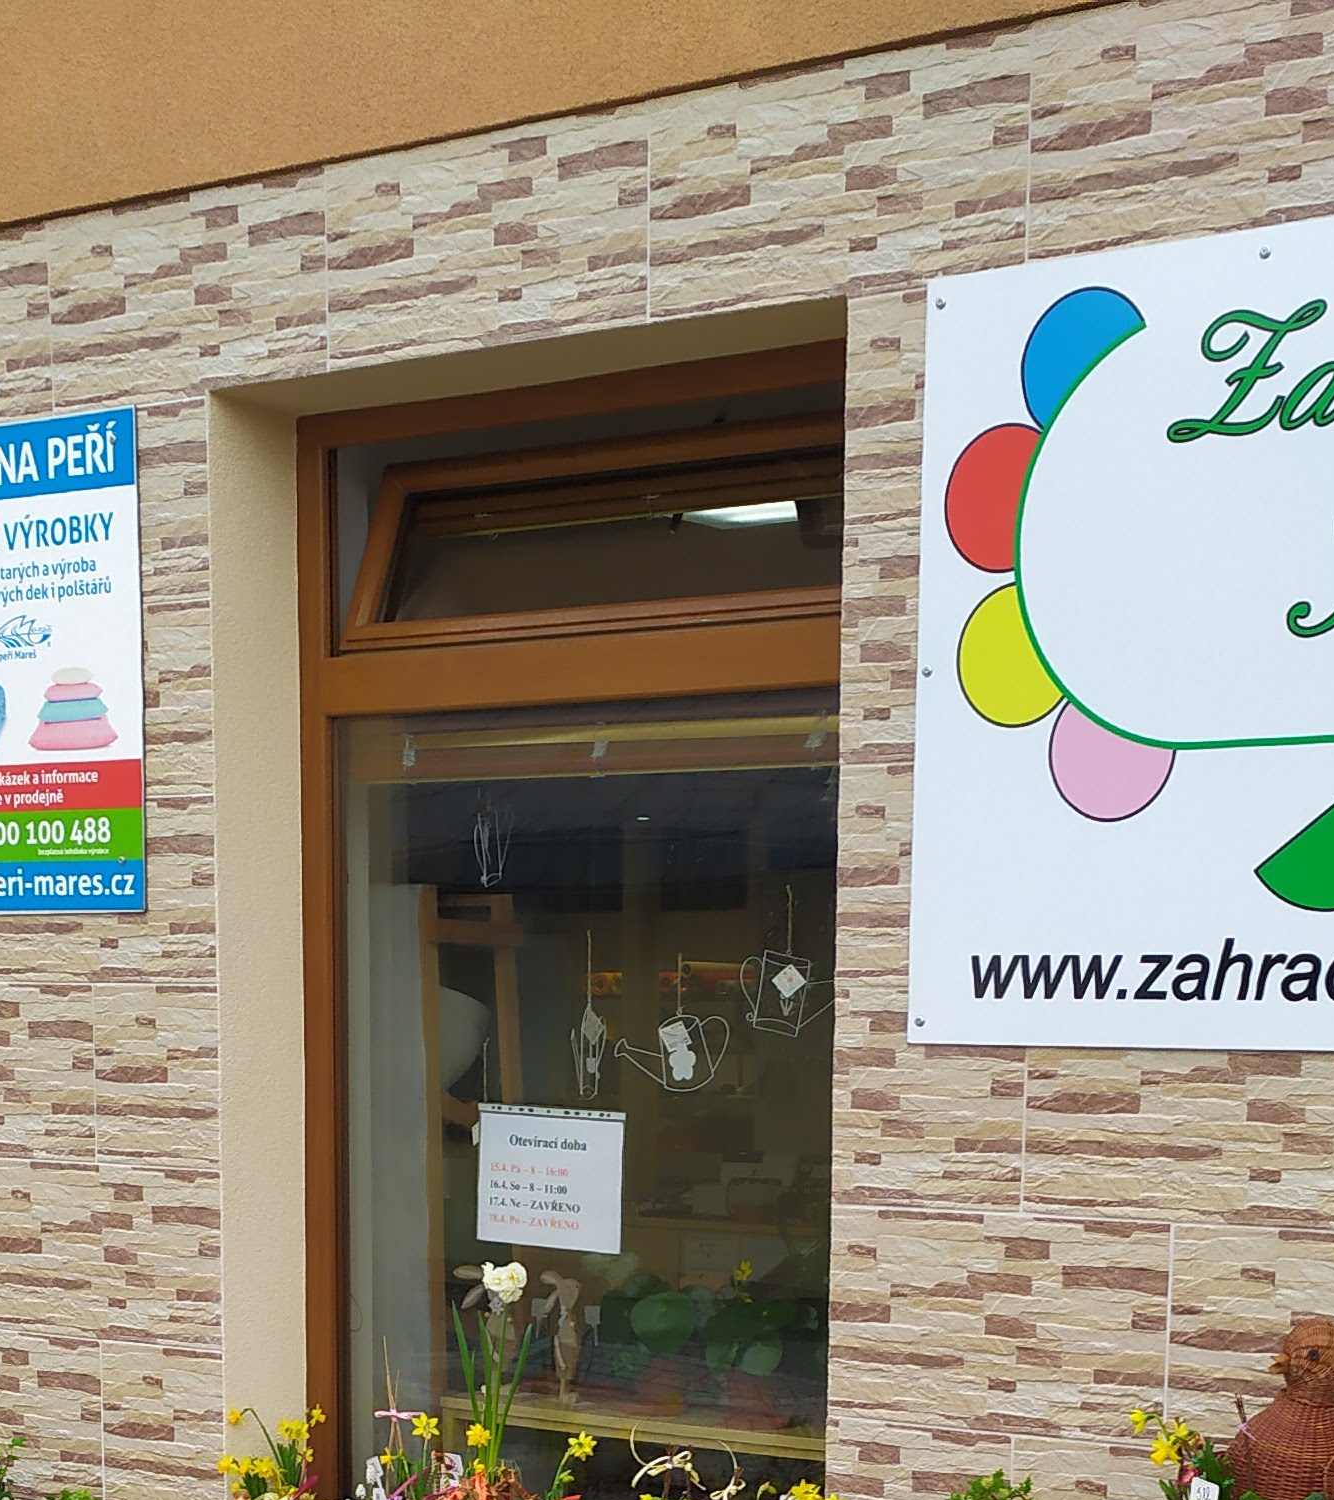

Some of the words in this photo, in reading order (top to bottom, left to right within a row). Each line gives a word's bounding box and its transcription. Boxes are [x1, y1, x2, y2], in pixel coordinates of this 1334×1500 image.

[47, 421, 117, 480] PEŘÍ
[4, 511, 114, 551] VÝROBKY
[42, 563, 50, 576] a
[51, 556, 97, 579] výroba
[25, 582, 49, 602] dek
[51, 582, 56, 598] i
[57, 575, 113, 602] polštářů
[32, 773, 40, 785] a
[41, 768, 99, 784] informace
[4, 793, 11, 805] v
[13, 787, 64, 808] prodejně
[26, 819, 65, 845] 100
[70, 816, 112, 846] 488
[509, 1133, 558, 1149] Otevírací
[560, 1137, 587, 1151] doba
[509, 1181, 520, 1191] So
[529, 1182, 535, 1192] 8
[544, 1184, 568, 1195] 11:00
[510, 1198, 521, 1207] Ne
[530, 1199, 581, 1214] ZAVŘENO
[529, 1216, 579, 1230] ZAVŘENO
